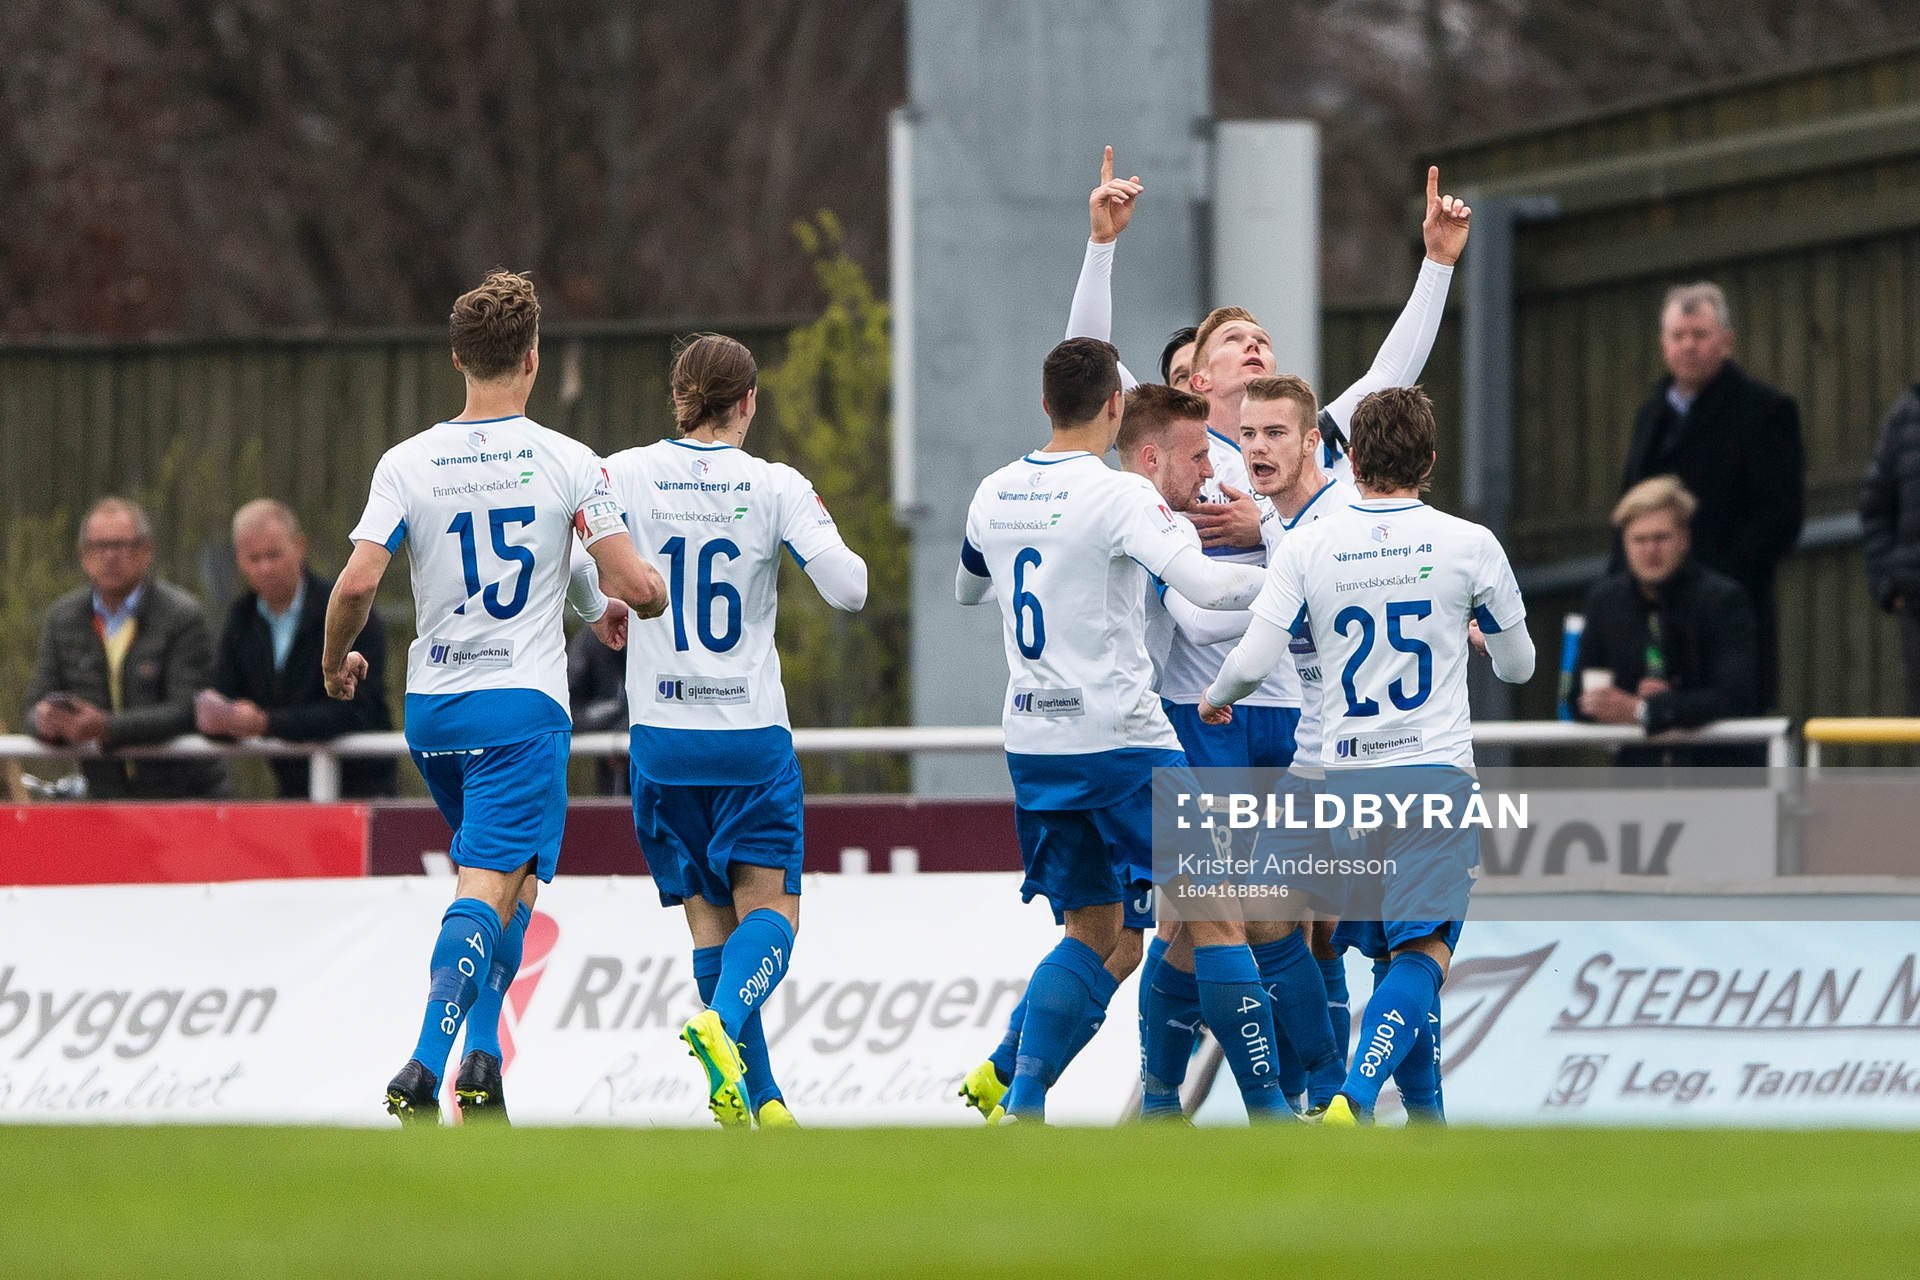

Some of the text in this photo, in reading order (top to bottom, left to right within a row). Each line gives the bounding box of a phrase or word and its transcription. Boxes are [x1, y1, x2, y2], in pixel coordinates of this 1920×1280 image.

[431, 449, 534, 467] Värnamo Energi AB
[432, 478, 519, 498] Finnvedsbostäder
[654, 480, 751, 494] Värnamo Energi AB
[651, 508, 732, 525] Finnvedsbostäder
[997, 491, 1069, 502] Värnamo Energi AB
[446, 505, 536, 621] 15
[1333, 544, 1433, 562] Värnamo Energi AB
[1336, 575, 1418, 593] Finnvedsbostäder
[658, 536, 742, 653] 16
[1013, 547, 1046, 660] 6
[1334, 600, 1433, 717] 25
[441, 932, 485, 1035] 4 oce
[555, 956, 1029, 1055] Rikyggen
[739, 946, 783, 1006] 4 office
[1559, 952, 1862, 1025] STEPHAN
[1237, 996, 1276, 1084] 4 offic
[1360, 1009, 1405, 1078] 4 office
[1620, 1060, 1715, 1103] Leg.
